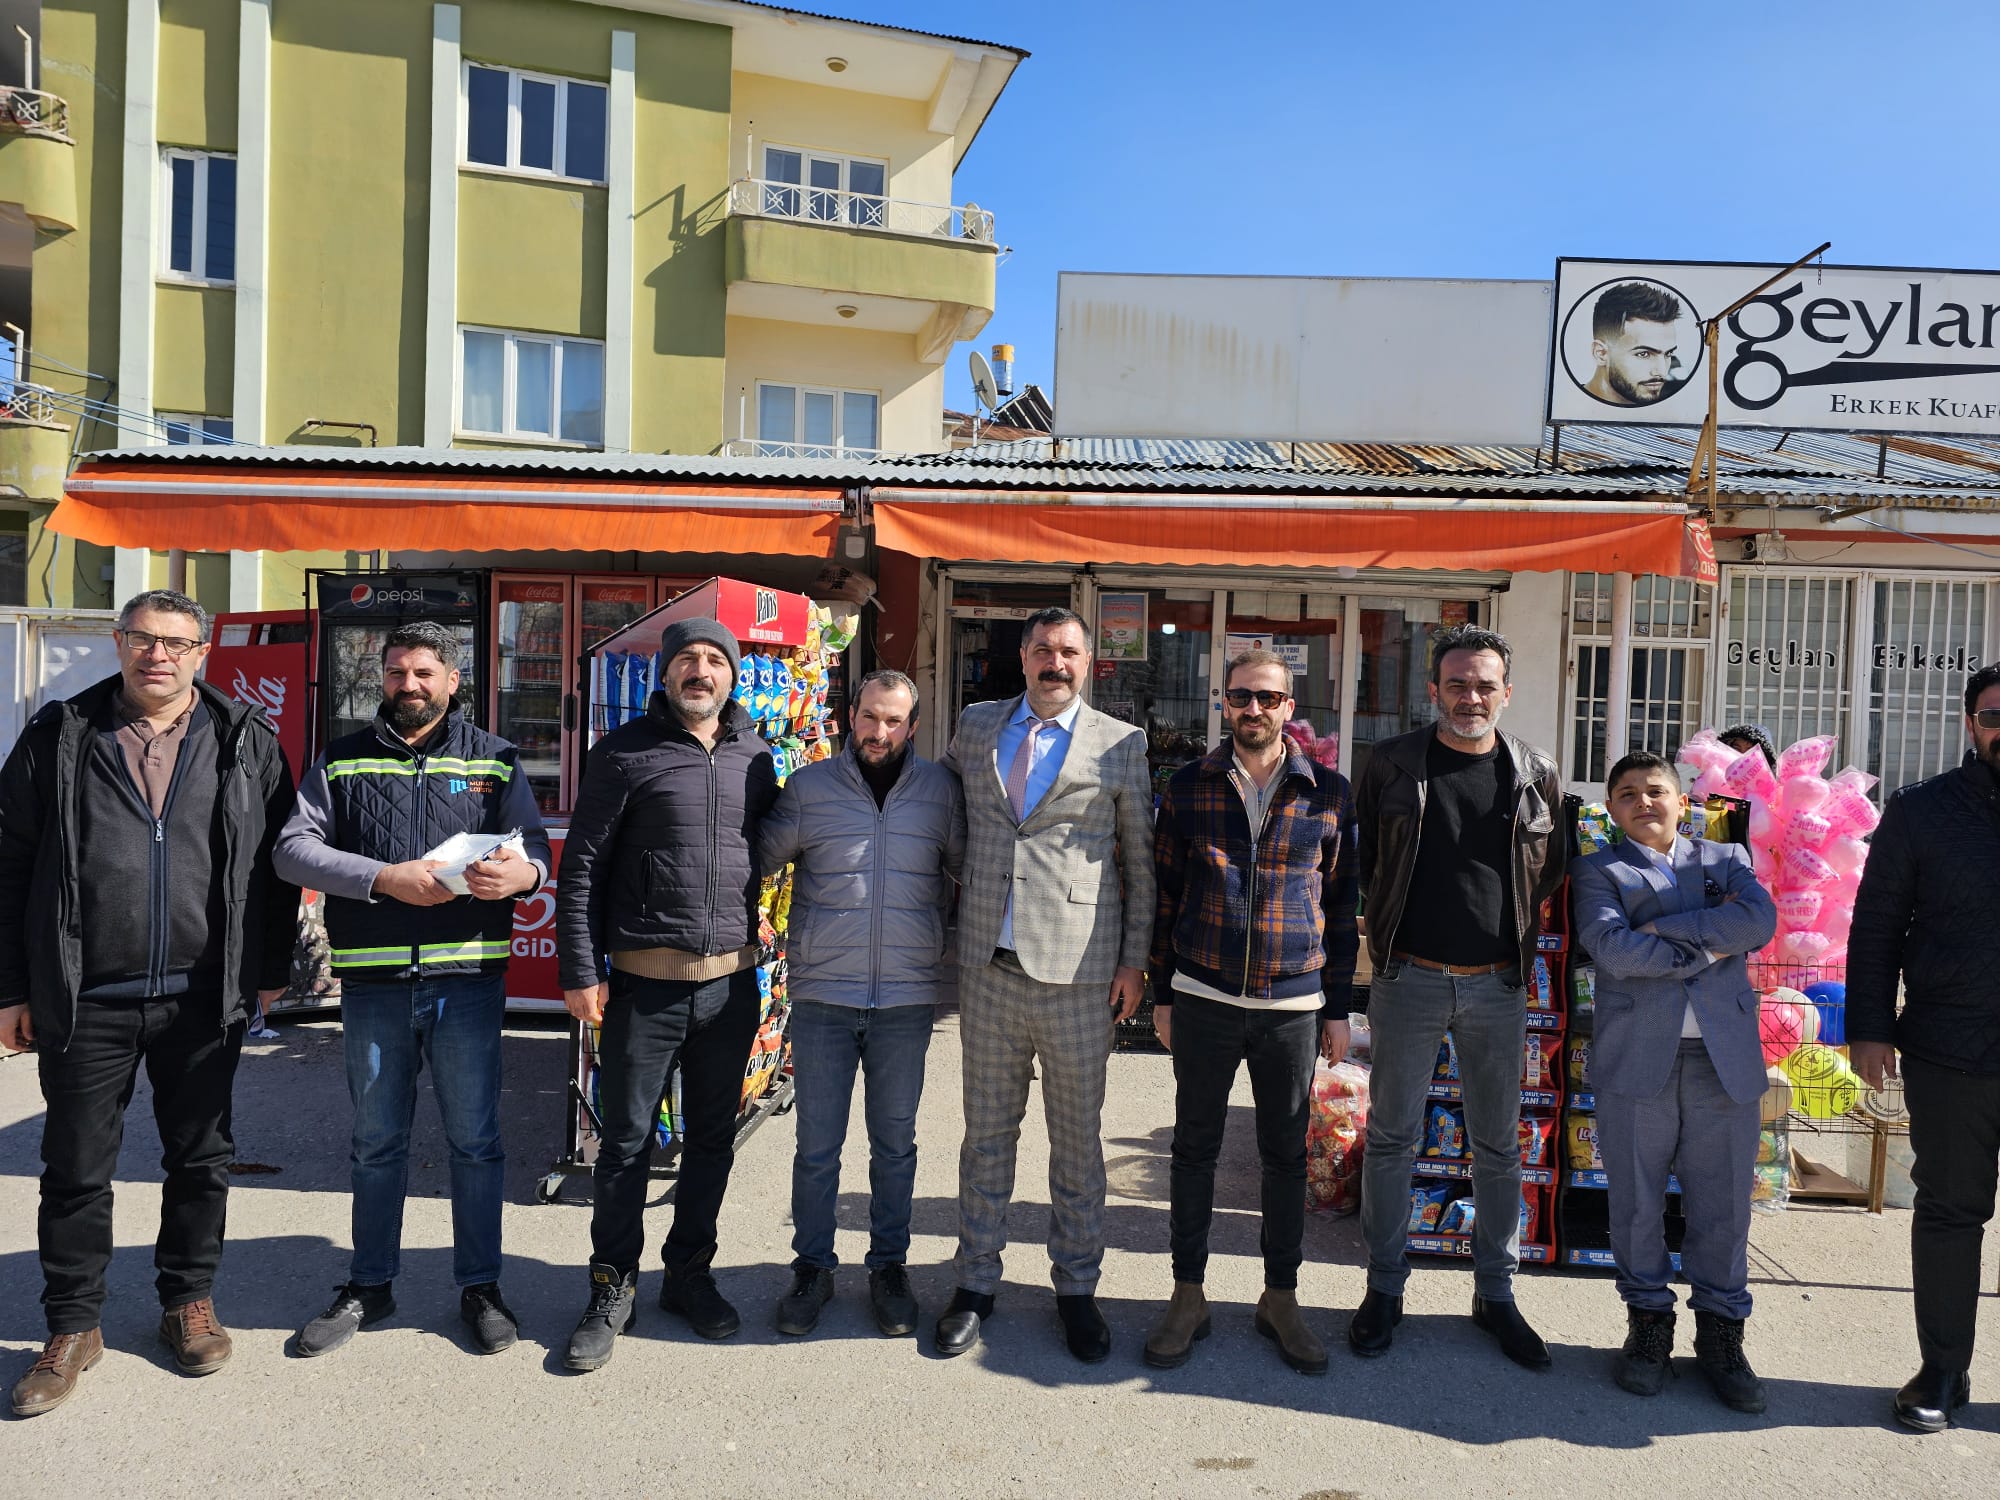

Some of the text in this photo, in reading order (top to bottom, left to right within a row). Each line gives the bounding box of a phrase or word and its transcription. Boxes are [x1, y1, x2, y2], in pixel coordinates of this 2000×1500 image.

[1830, 394, 2000, 419] ERKEK KUAF
[377, 587, 424, 605] pepsi
[1726, 640, 1979, 674] Geylan Erkek
[511, 936, 559, 958] GiD
